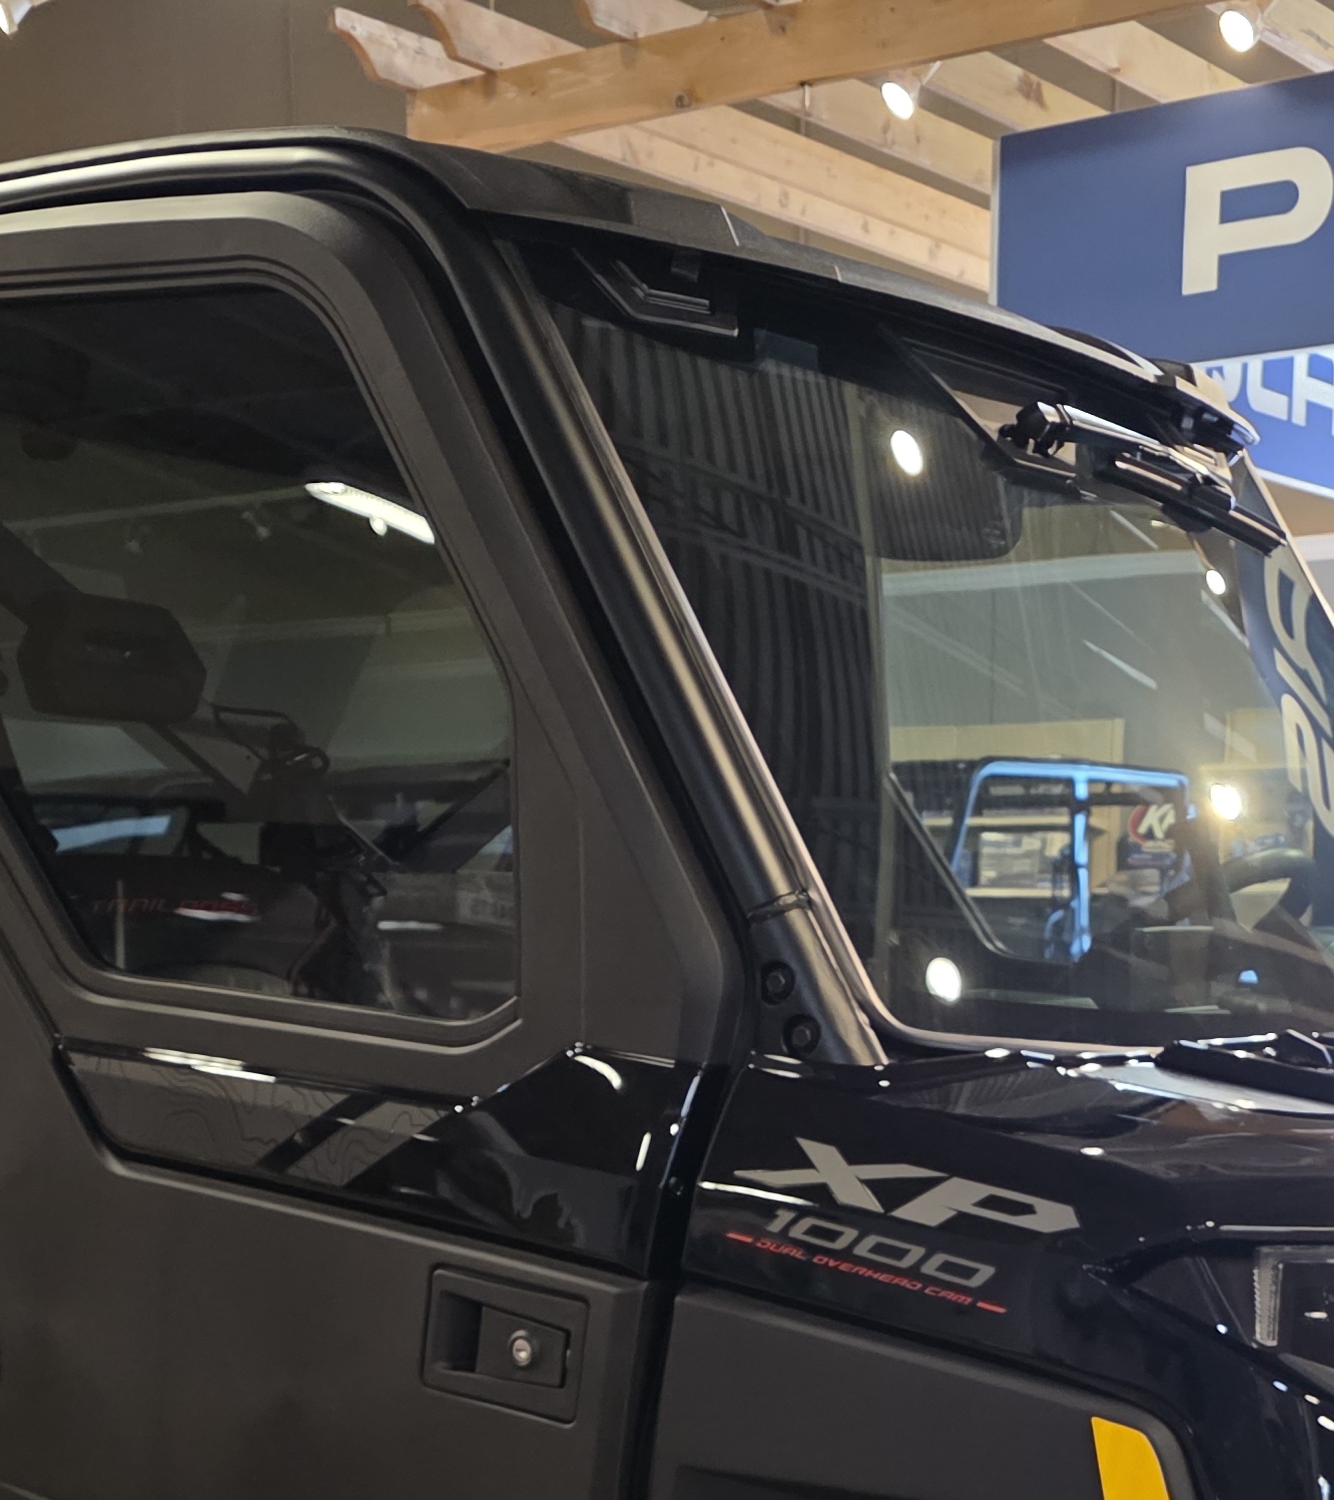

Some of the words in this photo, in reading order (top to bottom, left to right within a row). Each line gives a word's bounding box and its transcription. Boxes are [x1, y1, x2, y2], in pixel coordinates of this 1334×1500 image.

[733, 1136, 1080, 1233] XP
[756, 1238, 807, 1260] DUAL
[812, 1254, 924, 1291] OVERHEAD
[923, 1285, 973, 1306] CAM
[765, 1208, 996, 1288] 1000
